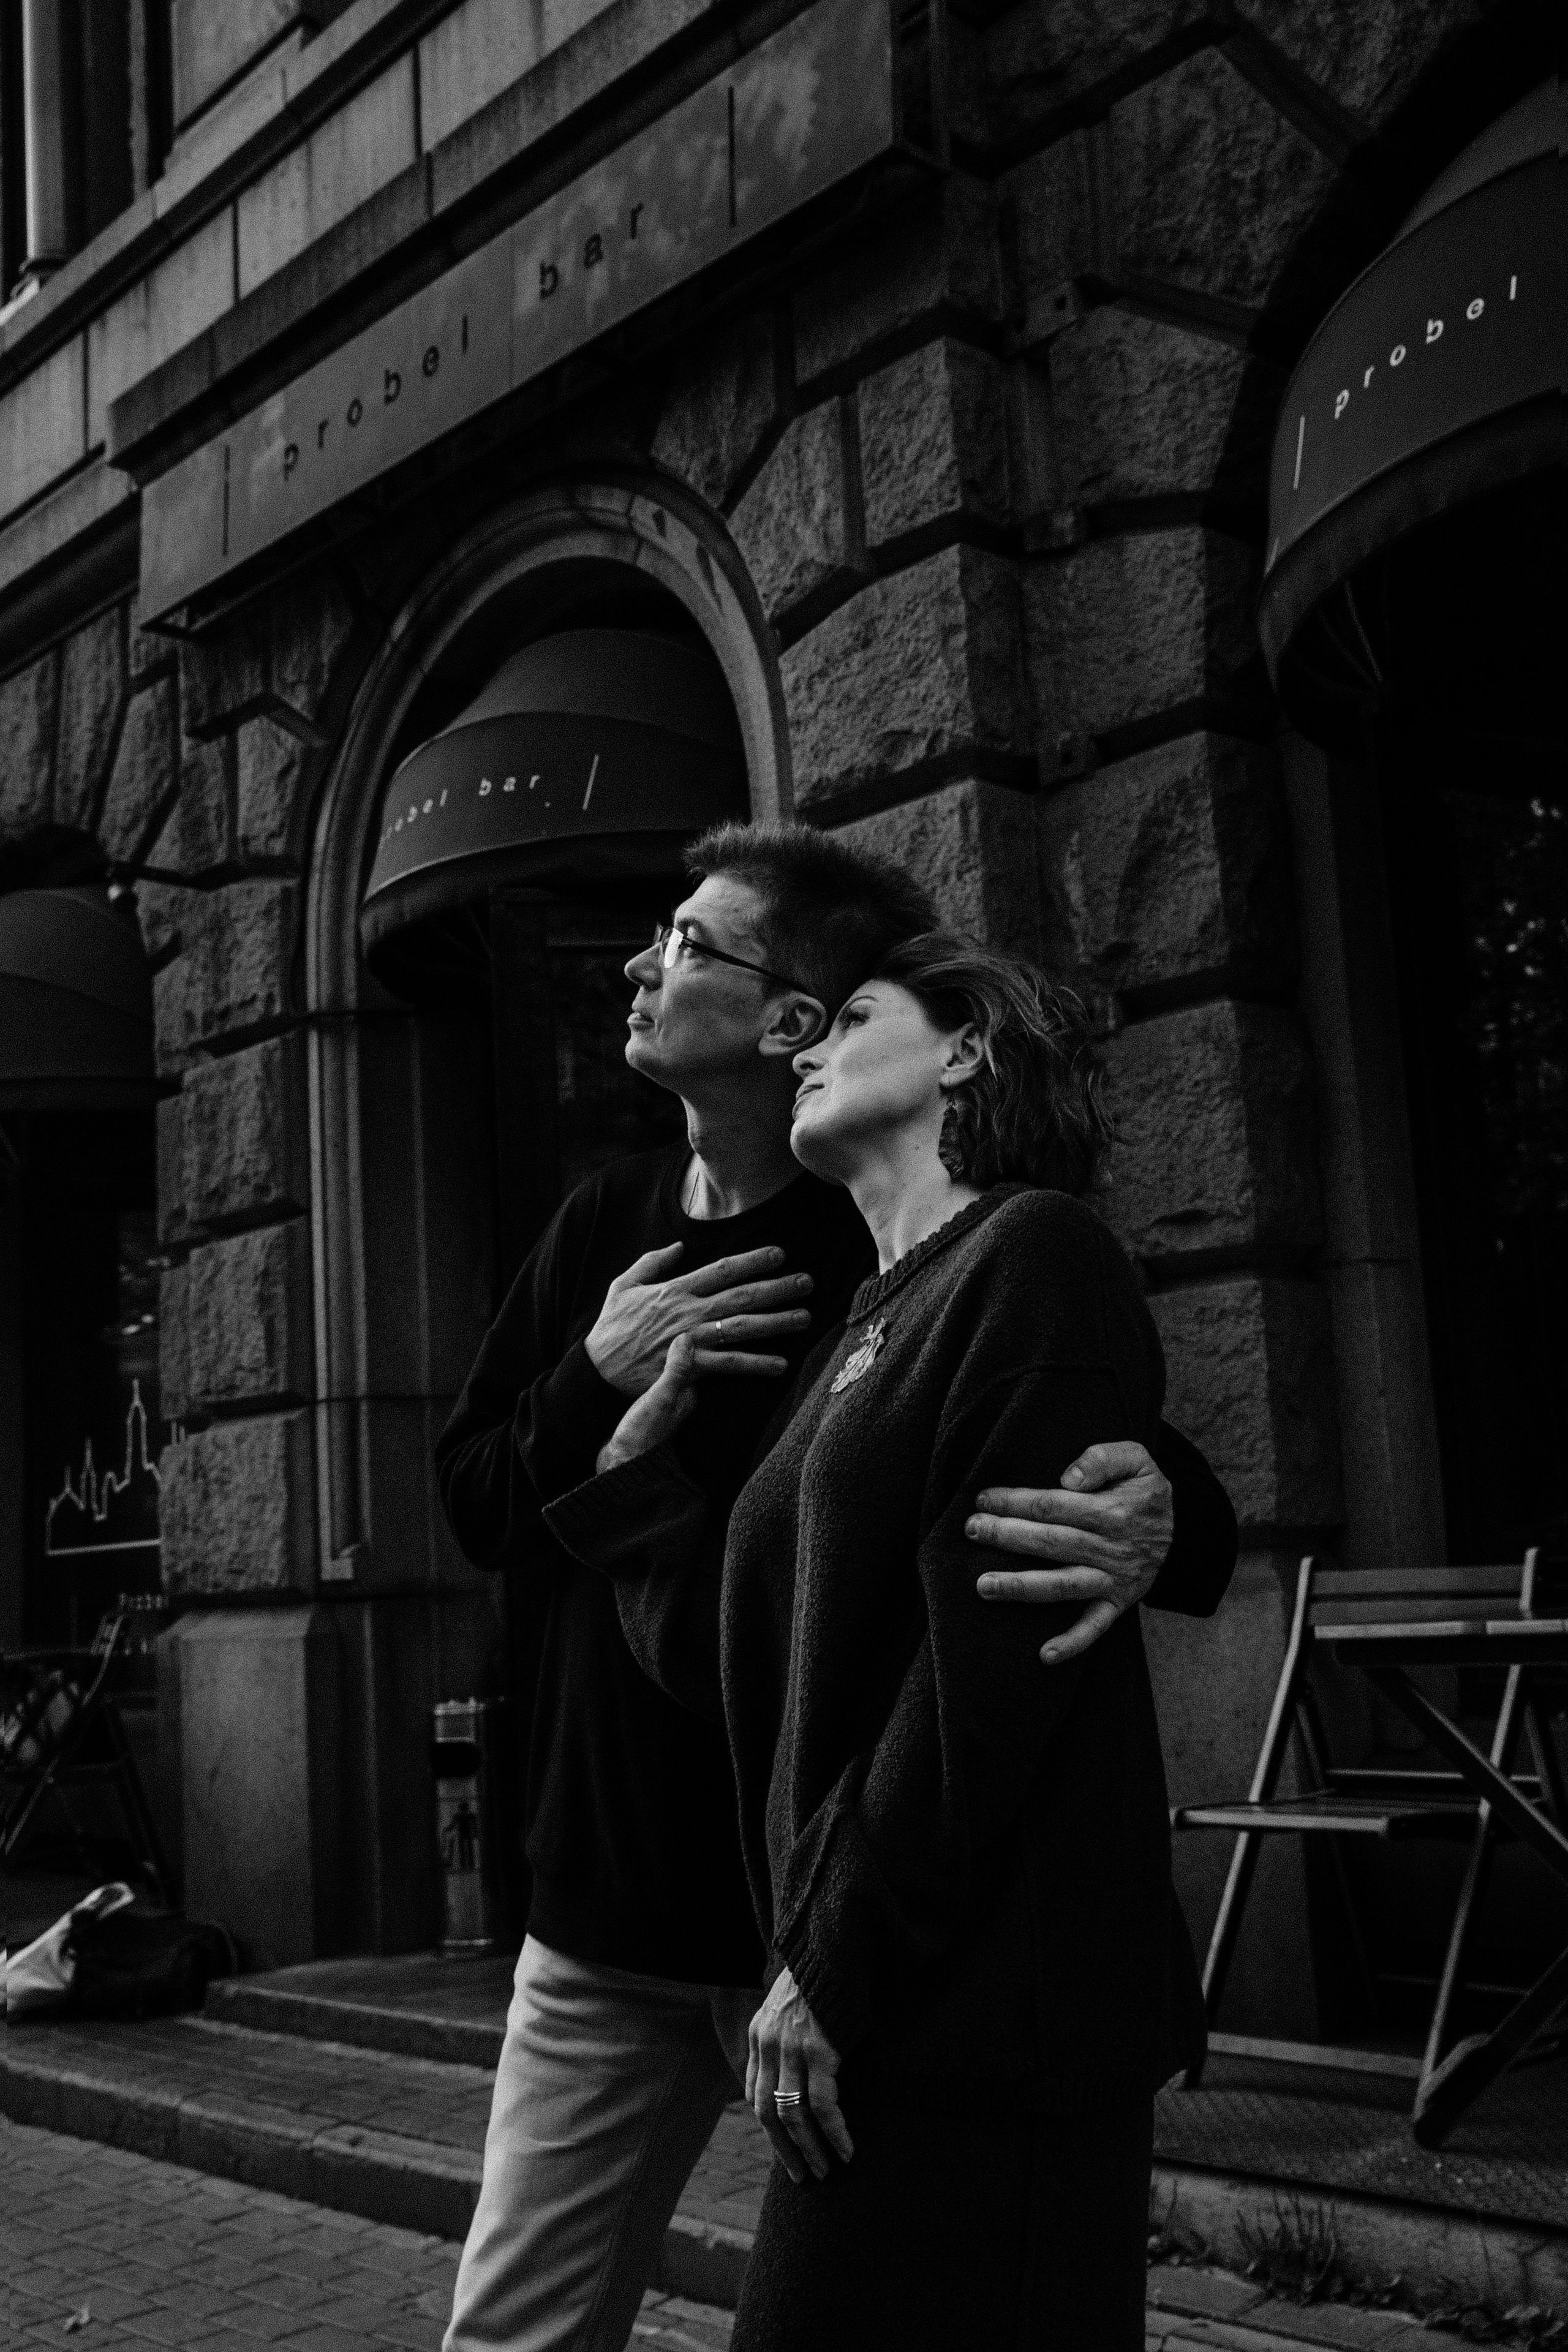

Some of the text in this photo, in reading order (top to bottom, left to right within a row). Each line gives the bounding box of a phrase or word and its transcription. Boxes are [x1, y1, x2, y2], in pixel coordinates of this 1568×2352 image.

[283, 202, 644, 481] probel bar
[1334, 274, 1518, 419] probel
